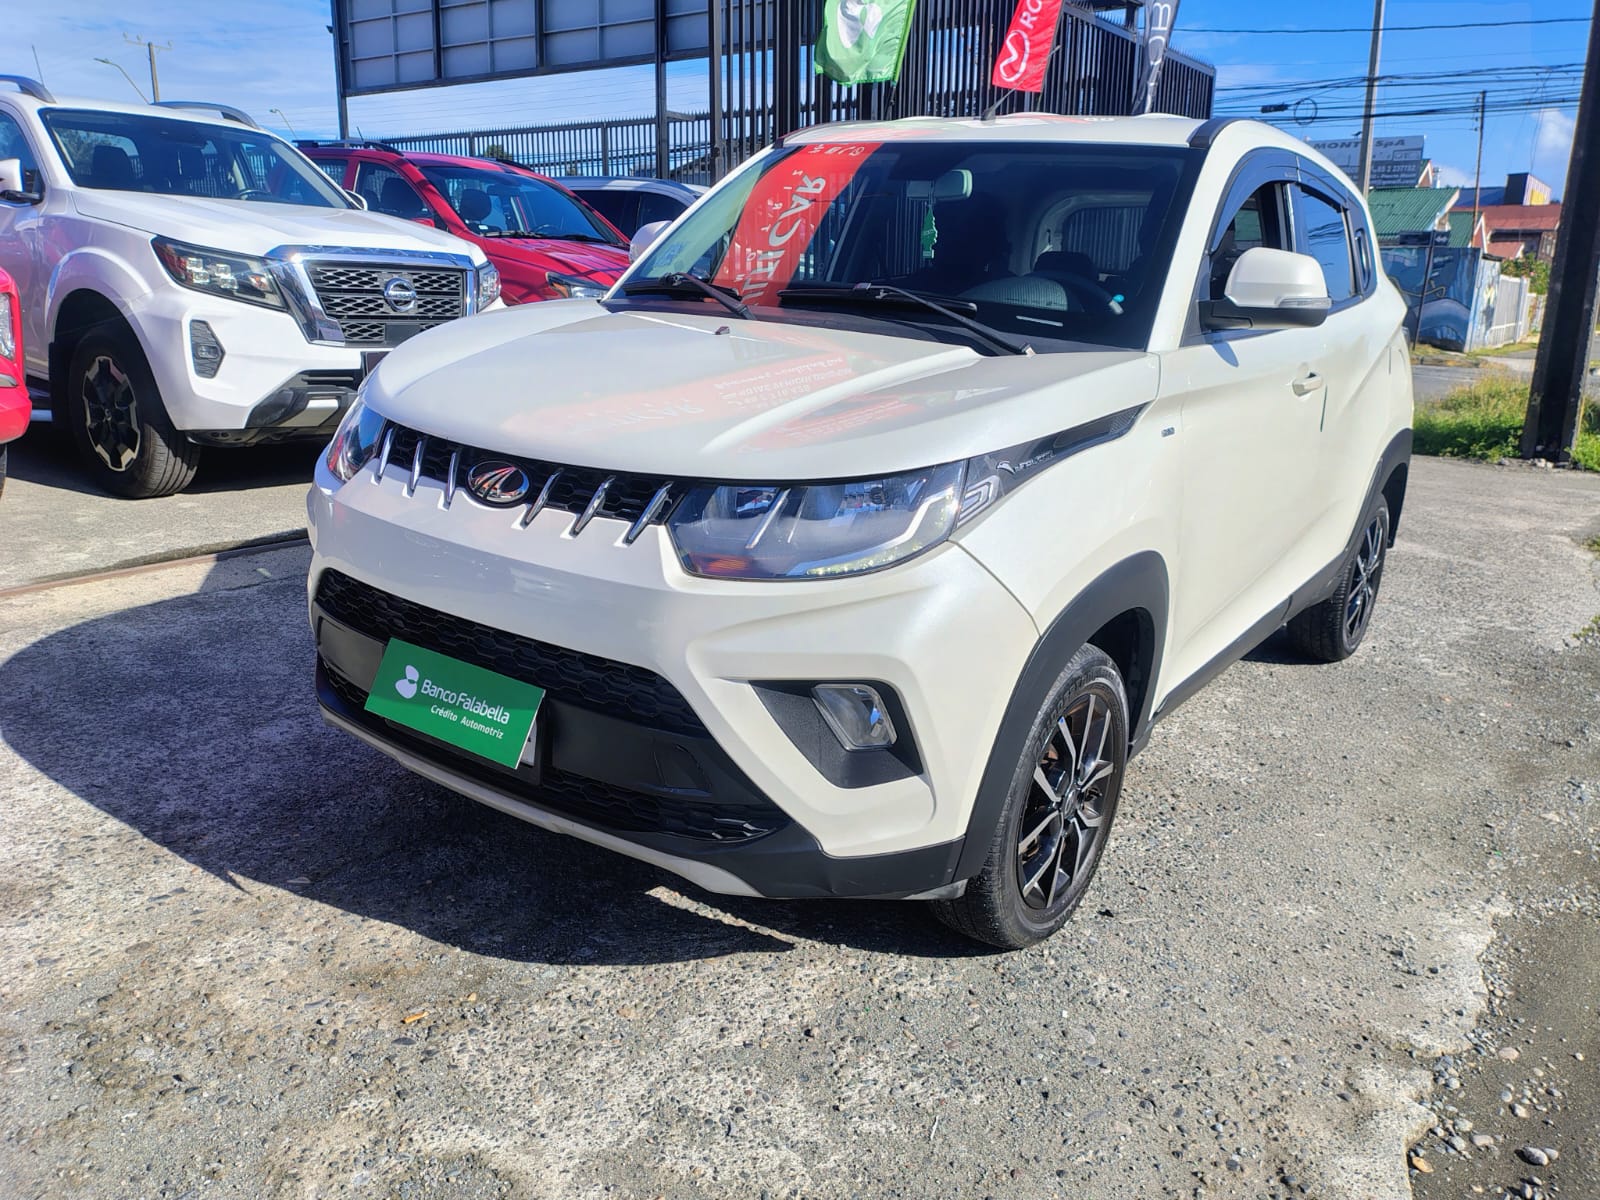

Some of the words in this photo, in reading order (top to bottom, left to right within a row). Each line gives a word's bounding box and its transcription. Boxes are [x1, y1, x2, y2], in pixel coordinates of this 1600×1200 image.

[1375, 139, 1405, 148] SpA
[420, 679, 457, 704] Banco
[456, 692, 510, 725] Falabella
[430, 704, 458, 722] Crédito
[460, 716, 504, 740] Automotriz
